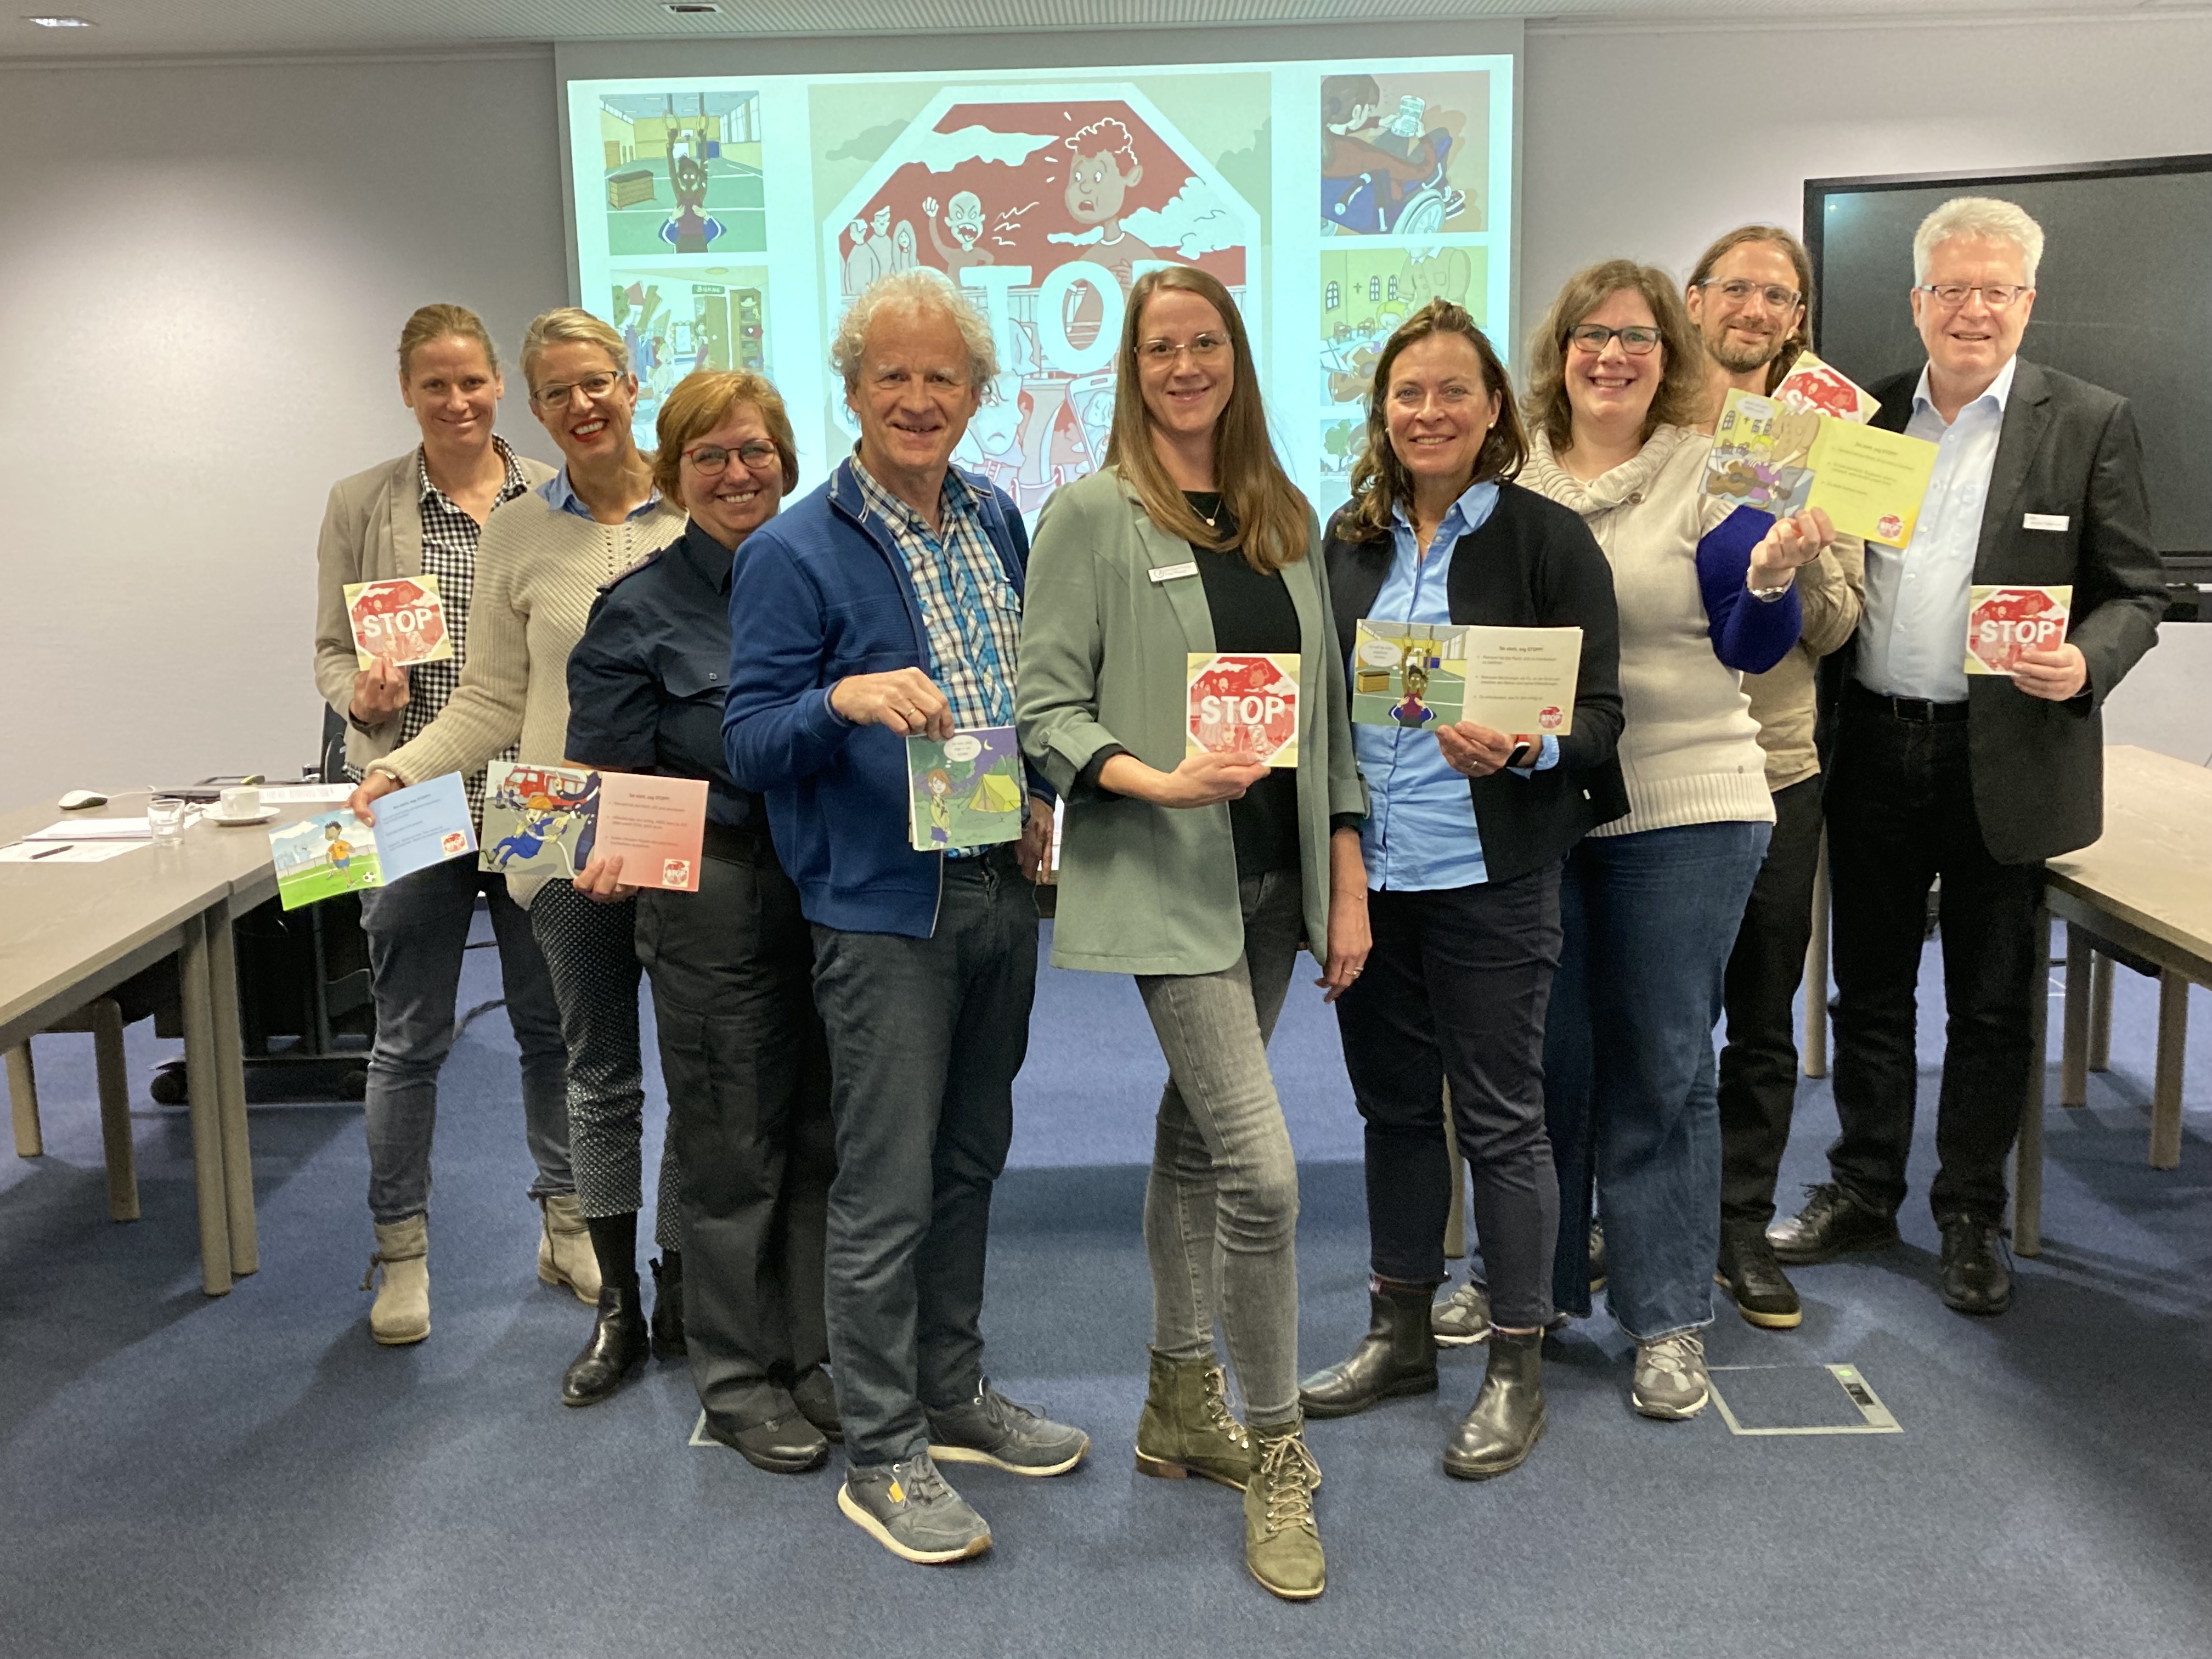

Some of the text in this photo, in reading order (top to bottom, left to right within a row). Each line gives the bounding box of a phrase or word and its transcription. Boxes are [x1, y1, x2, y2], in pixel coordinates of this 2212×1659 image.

[363, 608, 432, 637] STOP
[1980, 620, 2057, 643] STOP
[1201, 695, 1285, 725] STOP
